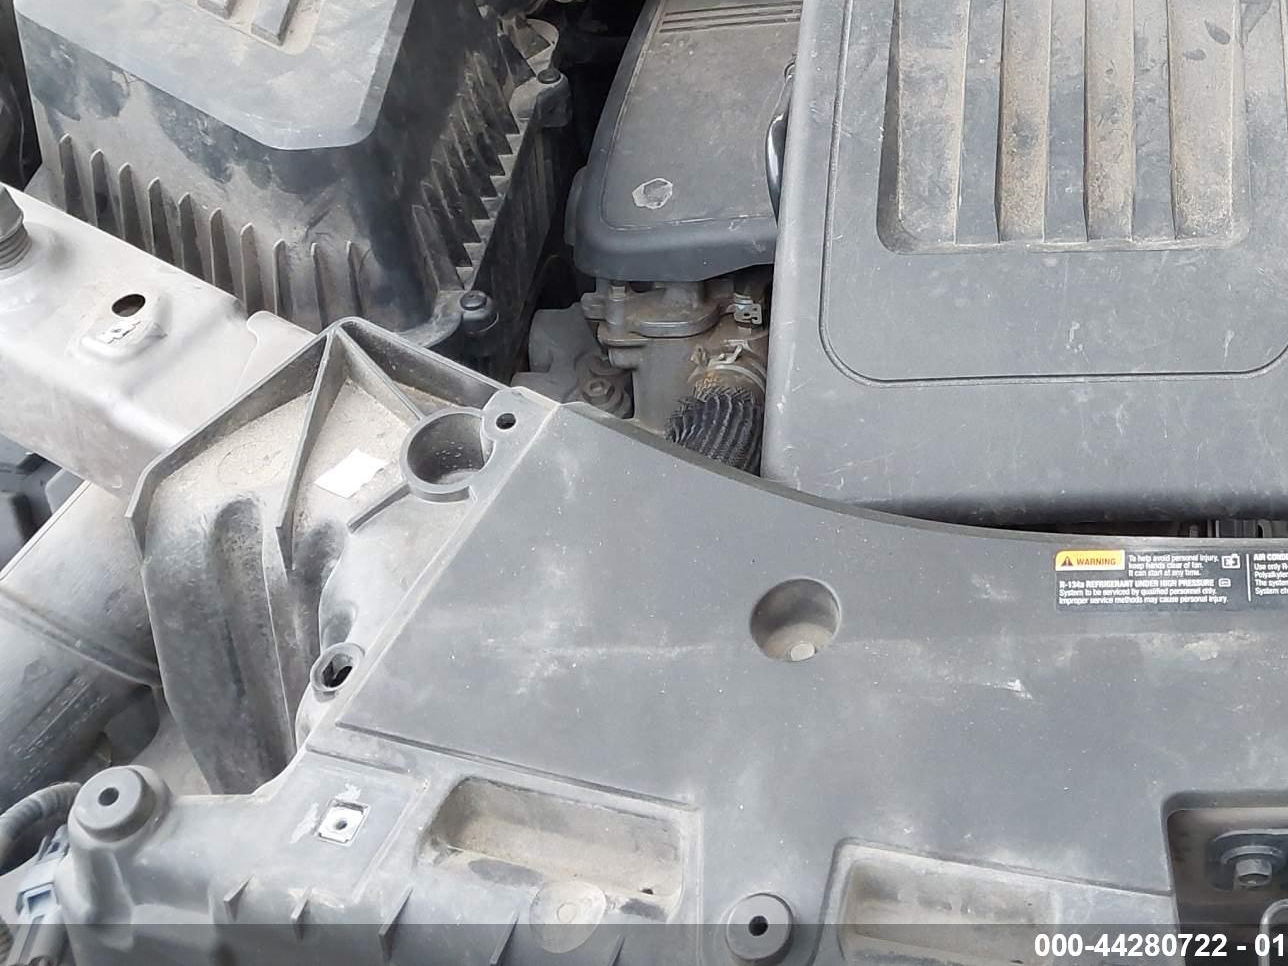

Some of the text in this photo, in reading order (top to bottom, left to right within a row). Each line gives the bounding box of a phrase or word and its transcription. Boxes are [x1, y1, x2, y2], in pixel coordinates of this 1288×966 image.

[1076, 558, 1116, 566] WARNING
[1152, 554, 1171, 562] avoid
[1171, 554, 1198, 563] personal
[1059, 580, 1085, 588] R-134a
[1059, 588, 1083, 597] System
[1179, 596, 1208, 604] personal
